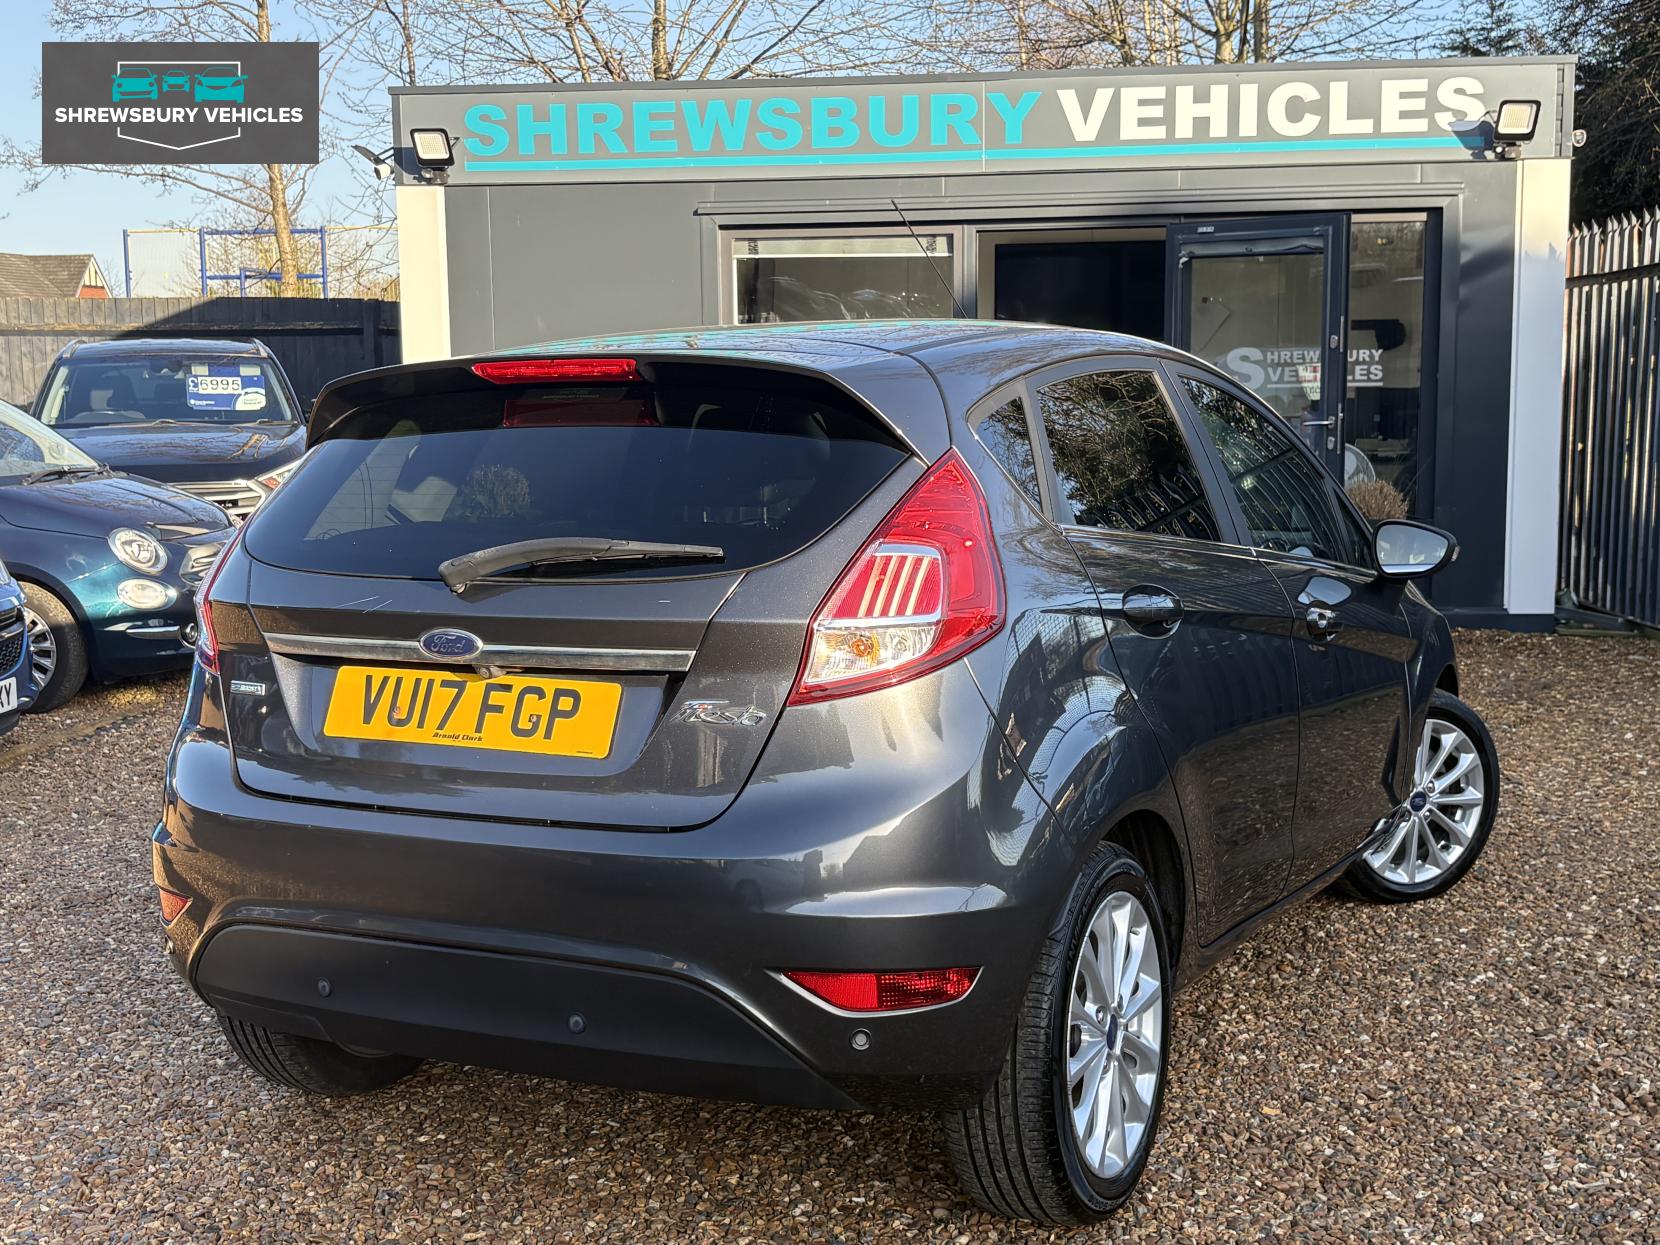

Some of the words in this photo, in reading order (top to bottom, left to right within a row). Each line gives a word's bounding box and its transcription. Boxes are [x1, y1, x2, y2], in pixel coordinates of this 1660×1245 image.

[464, 91, 1042, 157] SHREWSBURY
[1056, 76, 1486, 142] VEHICLES
[1267, 364, 1384, 382] VEES
[431, 634, 467, 653] Ford
[362, 674, 468, 730] VU17
[474, 682, 582, 741] FGP
[432, 731, 460, 741] Arnold
[461, 734, 484, 742] Clark
